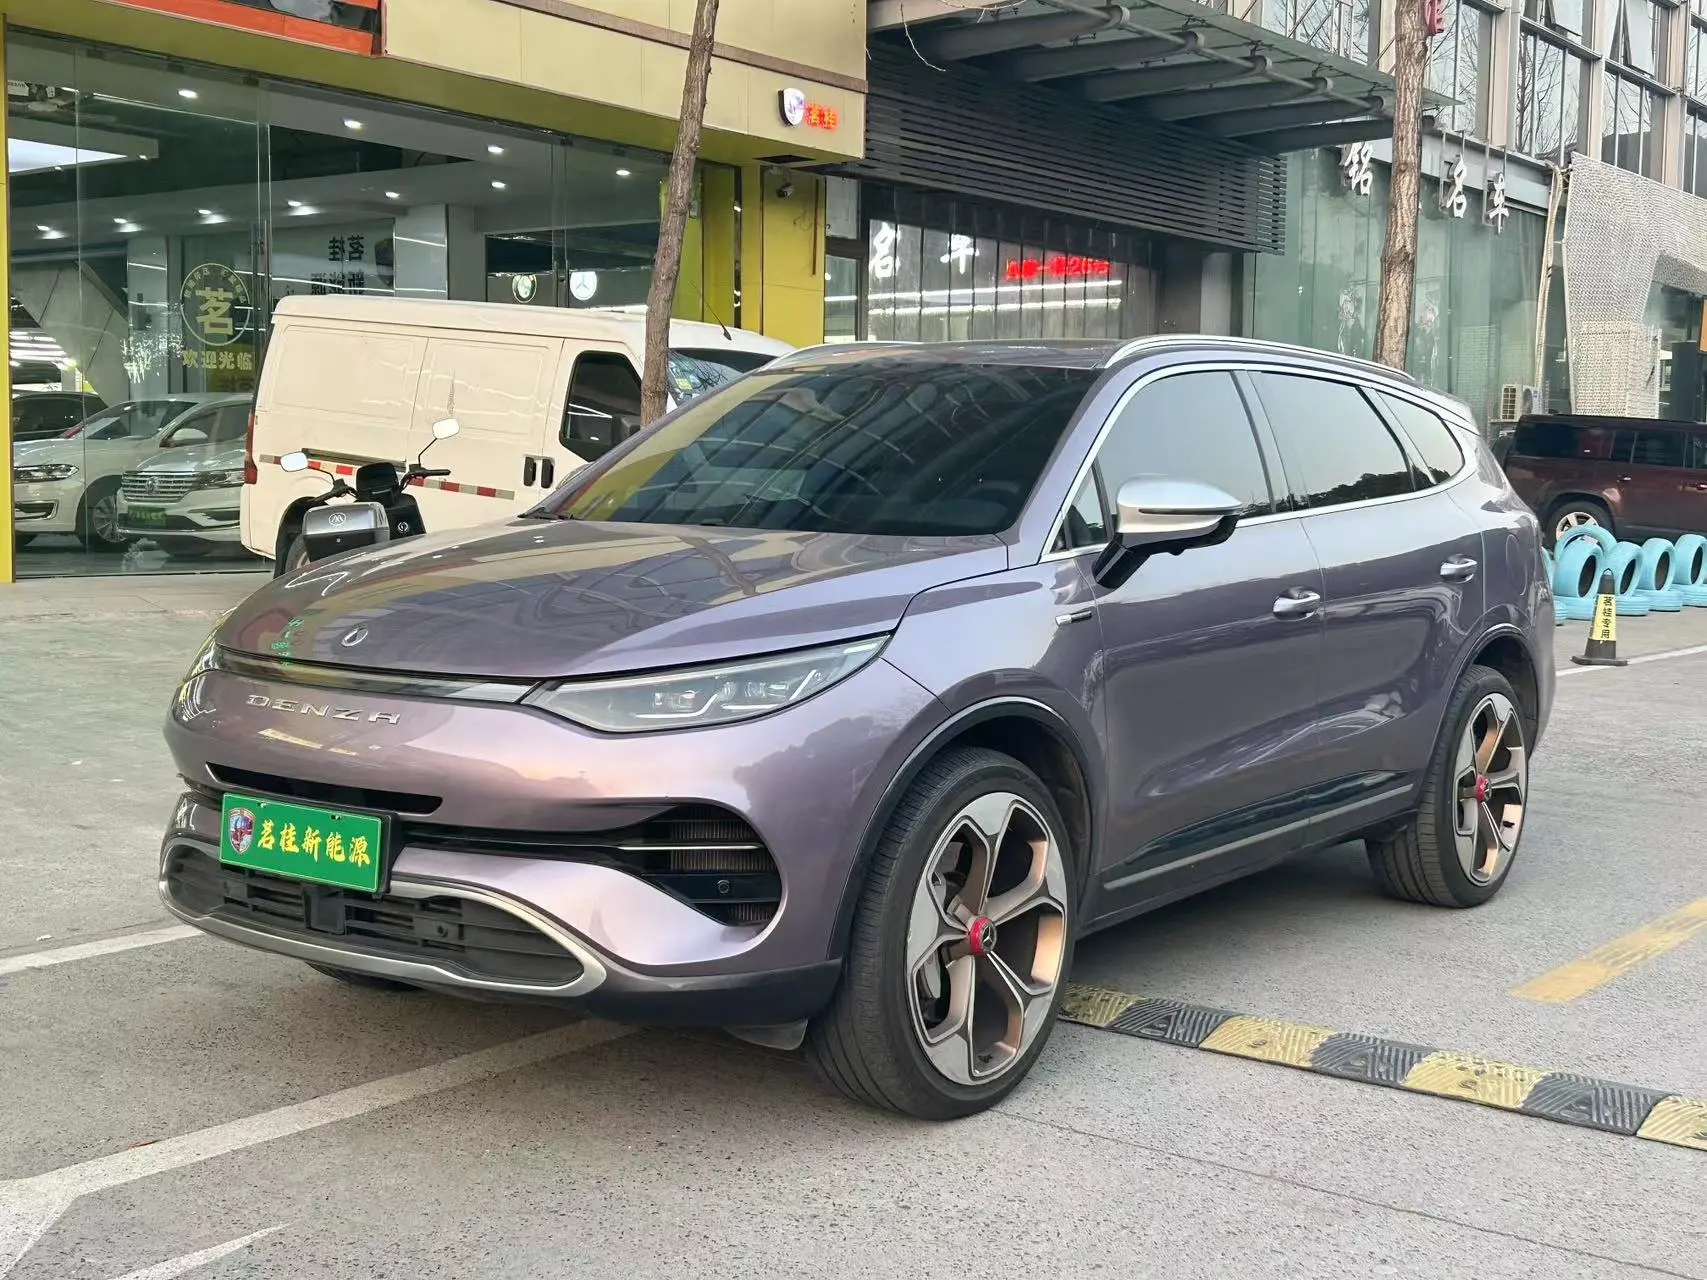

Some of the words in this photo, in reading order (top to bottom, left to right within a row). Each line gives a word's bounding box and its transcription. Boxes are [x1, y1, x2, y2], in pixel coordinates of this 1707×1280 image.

[182, 349, 253, 371] 欢迎光临
[246, 694, 401, 726] DENZA
[257, 818, 371, 867] 茗桂新能源
